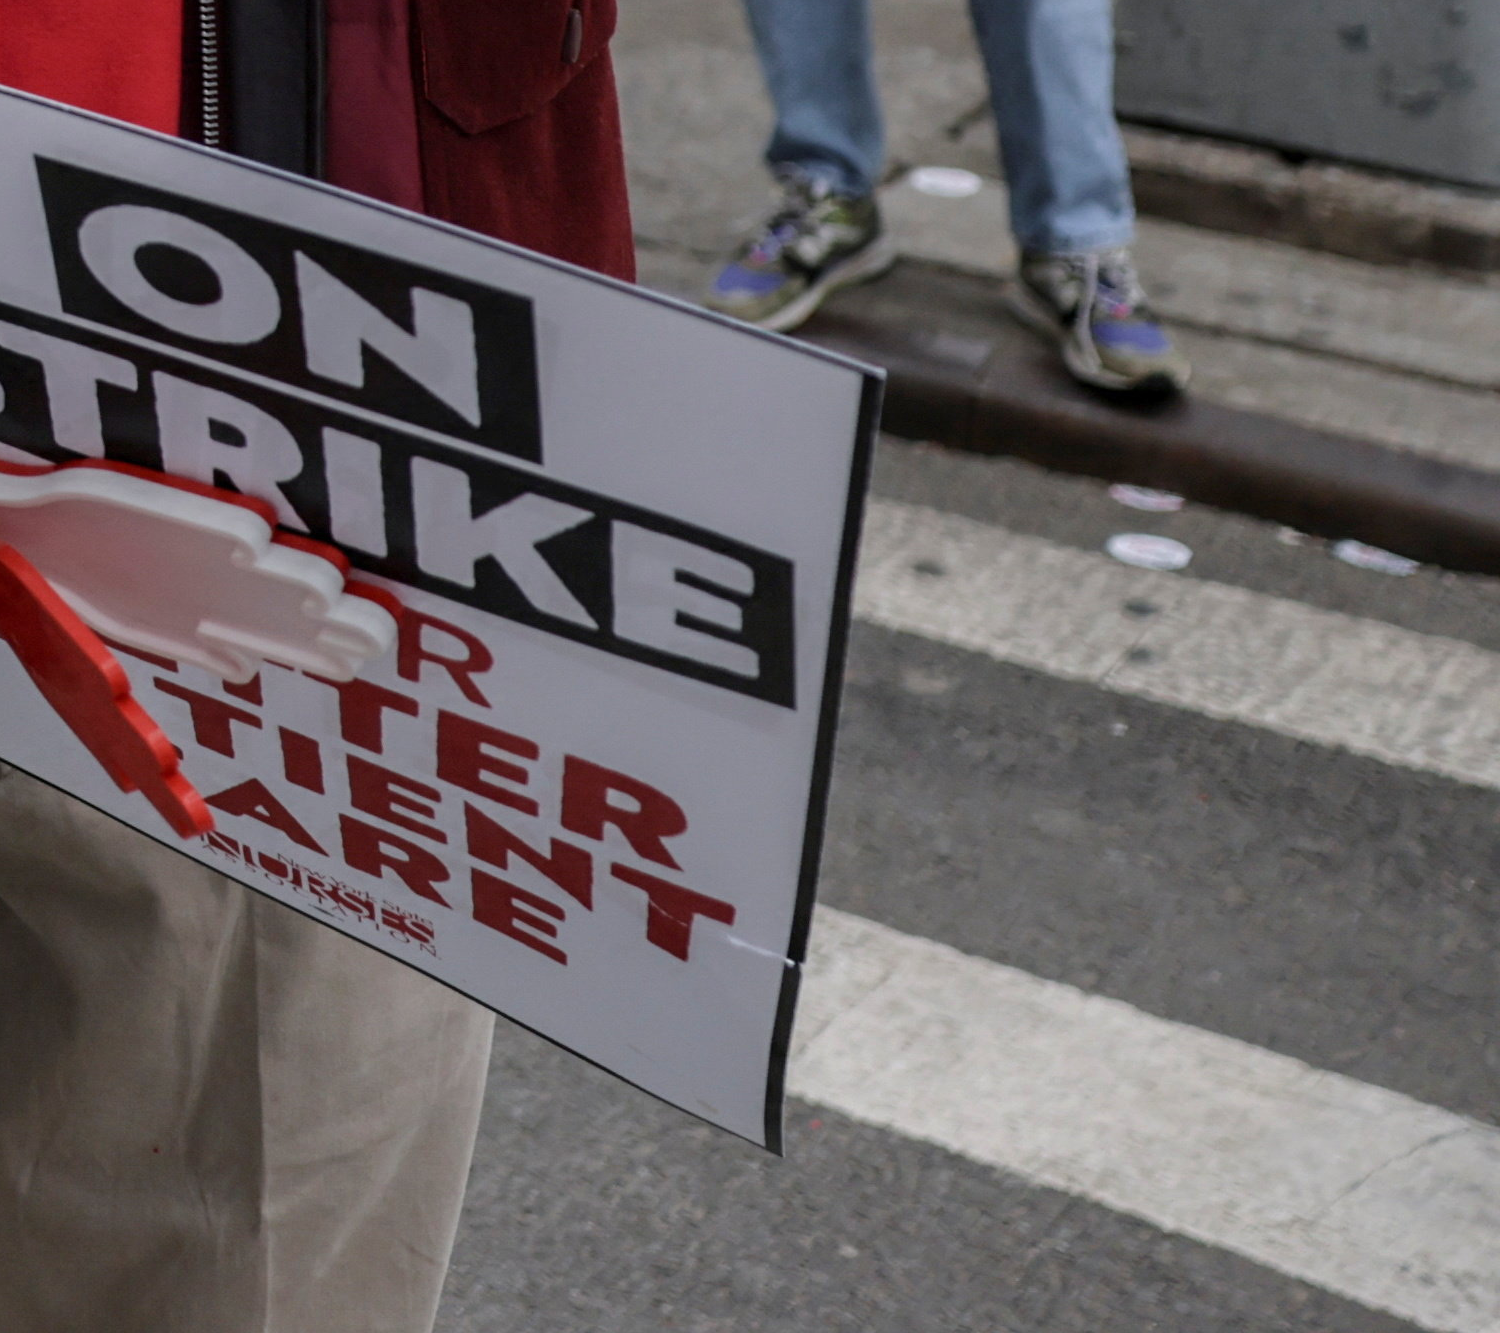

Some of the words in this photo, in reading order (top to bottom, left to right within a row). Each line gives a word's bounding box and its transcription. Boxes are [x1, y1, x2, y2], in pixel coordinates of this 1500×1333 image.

[78, 202, 482, 431] ON
[153, 675, 737, 964] TIENT
[176, 745, 569, 967] ARE
[200, 830, 435, 945] NURSES
